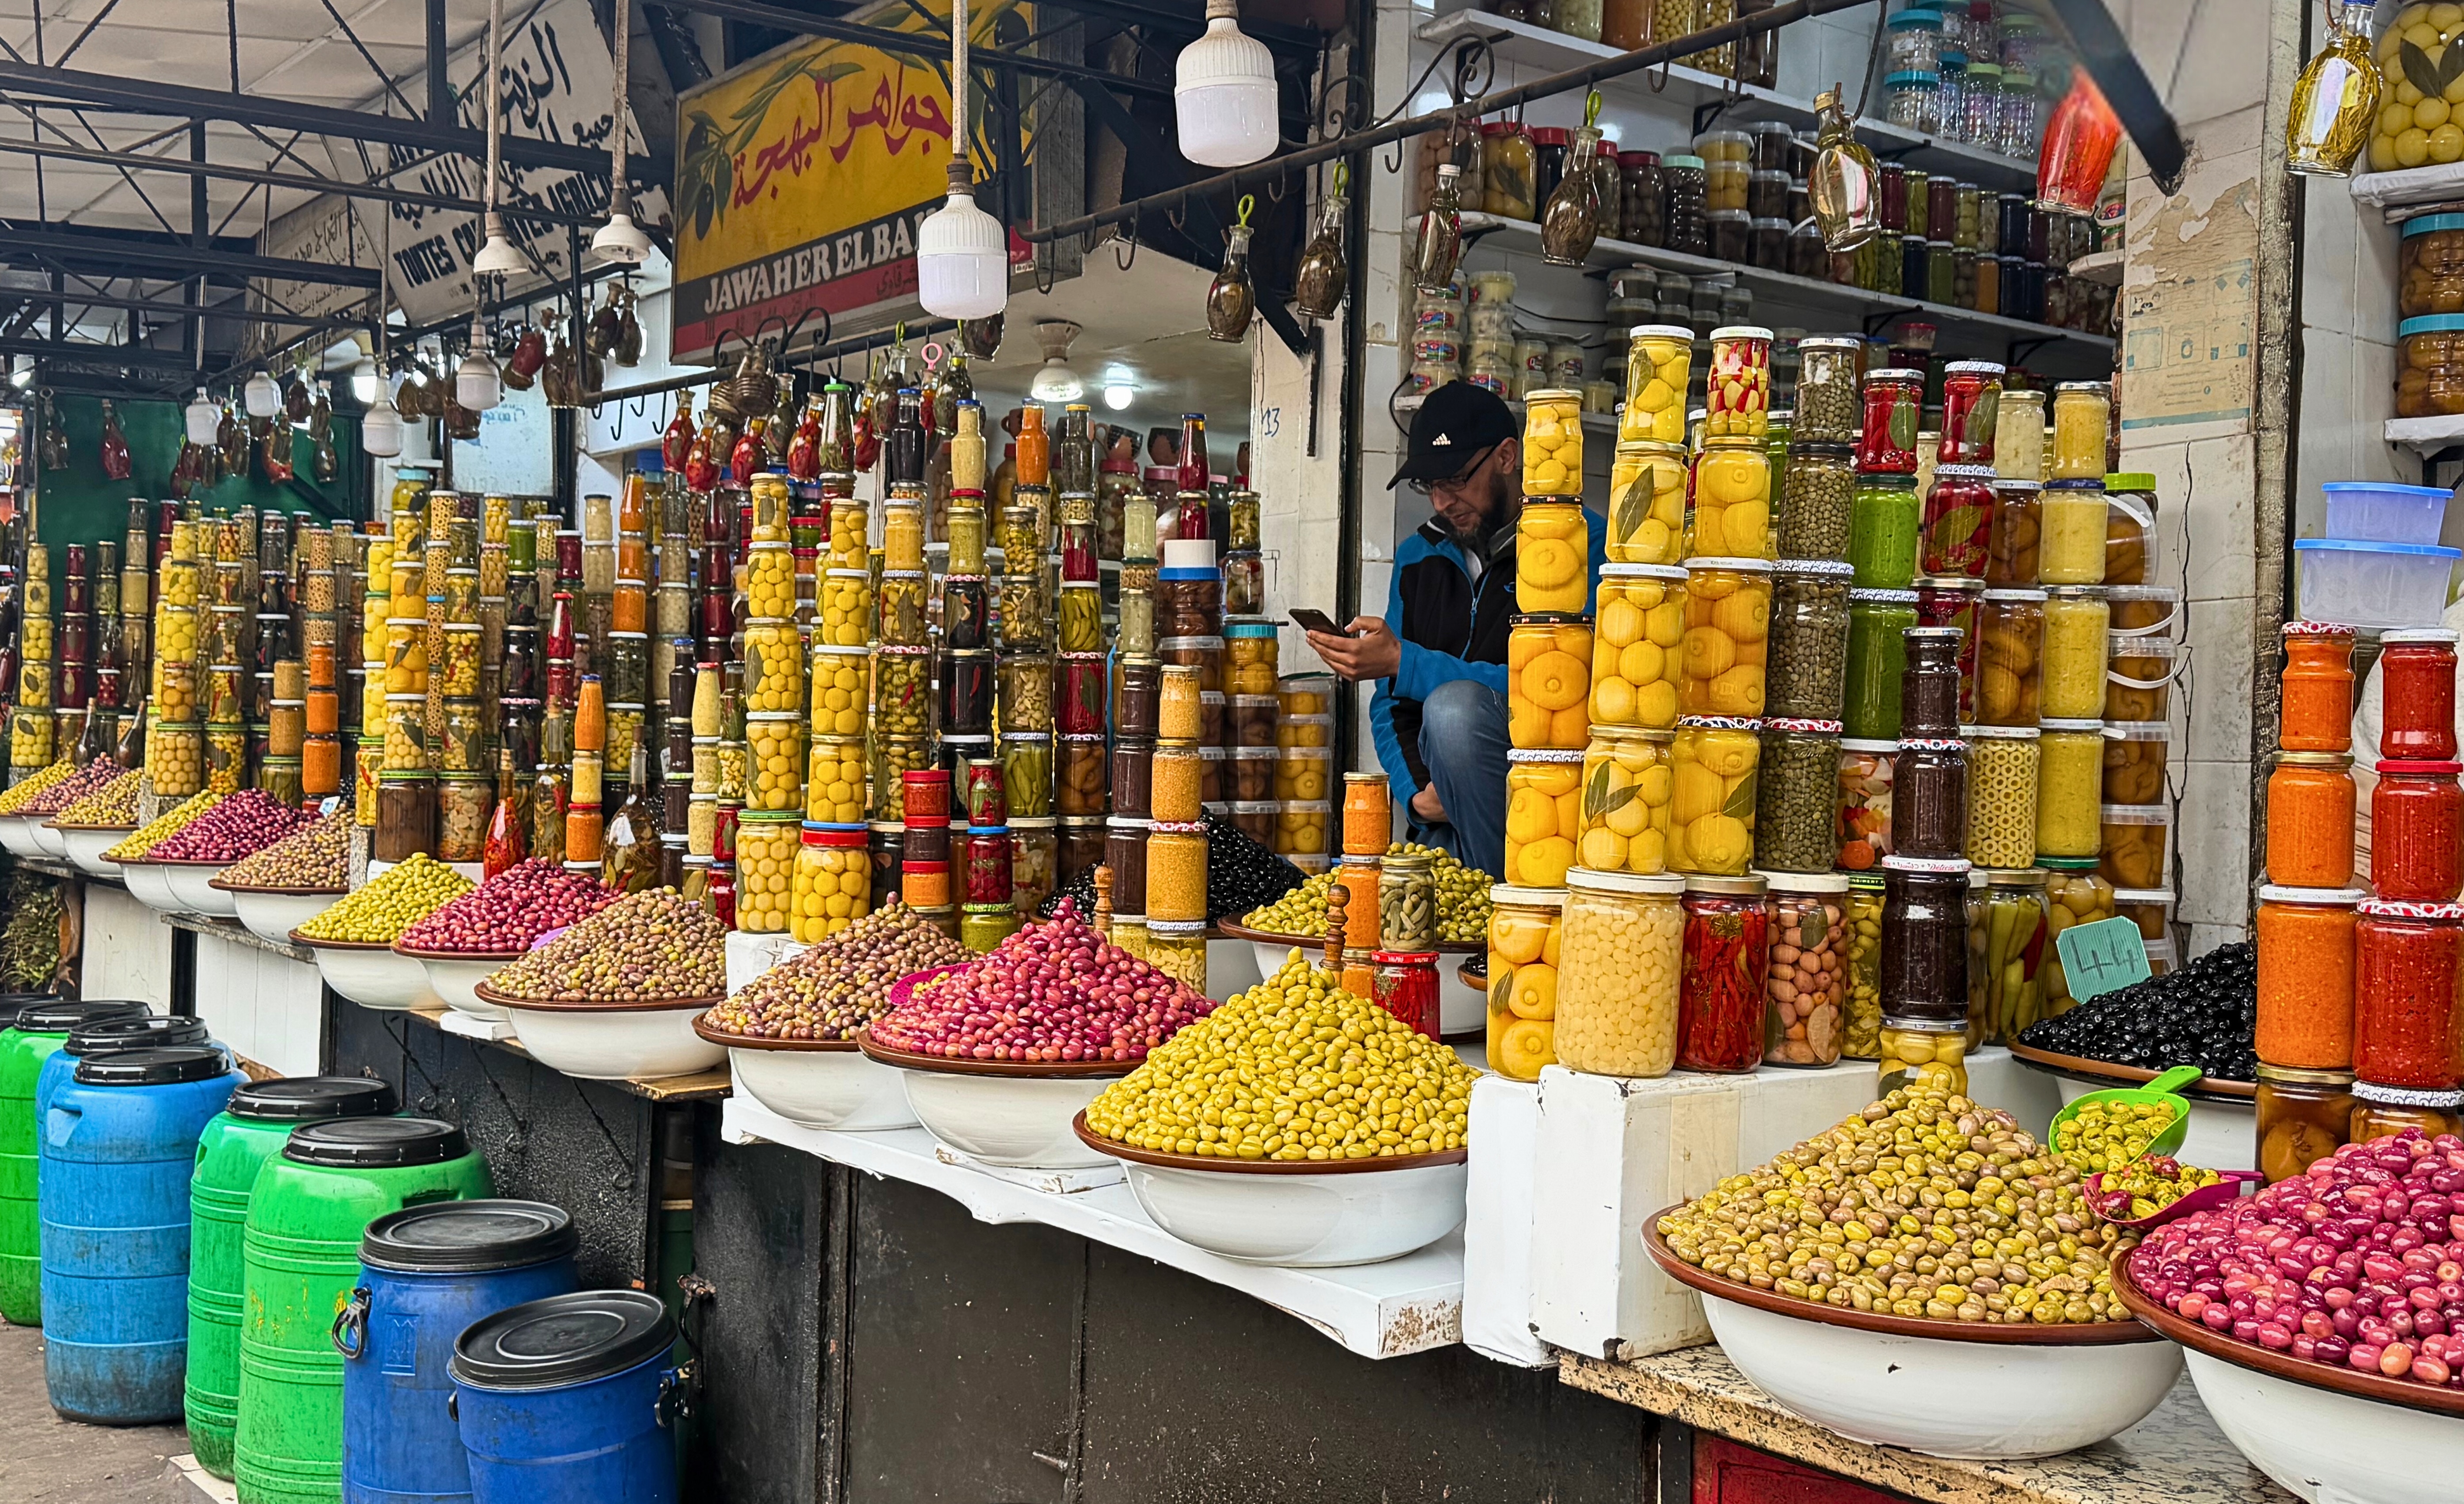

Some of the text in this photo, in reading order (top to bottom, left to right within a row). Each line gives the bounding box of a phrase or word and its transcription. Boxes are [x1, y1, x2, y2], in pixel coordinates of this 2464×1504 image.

[733, 61, 953, 210] جواهر البهجة
[393, 234, 458, 288] TOUTES
[704, 243, 832, 314] JAWAHER
[835, 231, 869, 276] EL
[1262, 407, 1280, 437] 13
[2071, 928, 2139, 979] 44
